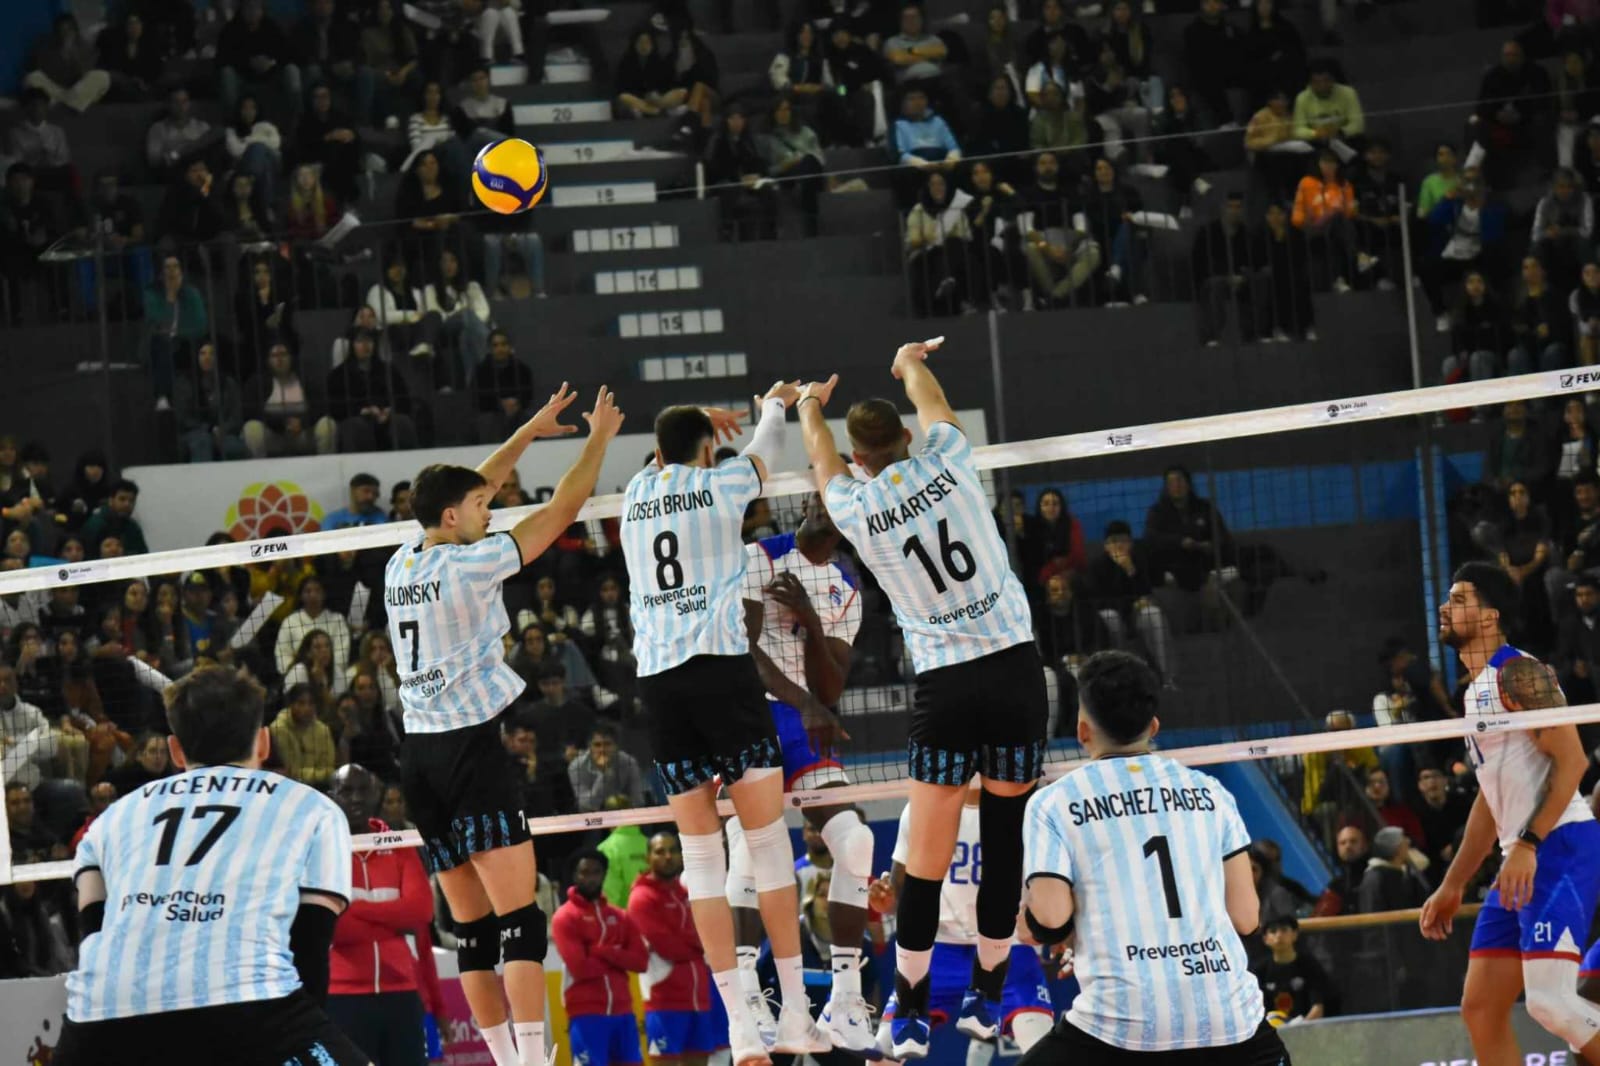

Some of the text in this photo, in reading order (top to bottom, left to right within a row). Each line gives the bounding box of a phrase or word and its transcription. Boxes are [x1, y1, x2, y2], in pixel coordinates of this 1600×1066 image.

[552, 107, 573, 122] 20
[574, 146, 594, 160] 19
[597, 187, 615, 202] 18
[617, 230, 636, 246] 17
[661, 314, 682, 331] 15
[685, 360, 704, 376] 14
[627, 489, 714, 522] LOSER BRUNO
[866, 468, 958, 537] KUKARTSEV
[264, 542, 288, 554] FEVA
[902, 517, 977, 594] 16
[653, 530, 684, 591] 8
[385, 580, 440, 607] ALONSKY
[643, 584, 706, 608] Prevención
[675, 597, 707, 616] Salud
[399, 620, 419, 672] 7
[402, 669, 444, 689] revención
[143, 776, 279, 798] VICENTIN
[1068, 787, 1216, 826] SANCHEZ PAGES
[152, 804, 242, 866] 17
[1142, 835, 1182, 918] 1
[165, 903, 224, 923] Salud
[1534, 921, 1552, 942] 21
[1126, 937, 1223, 961] Prevención
[1182, 954, 1231, 976] Salud
